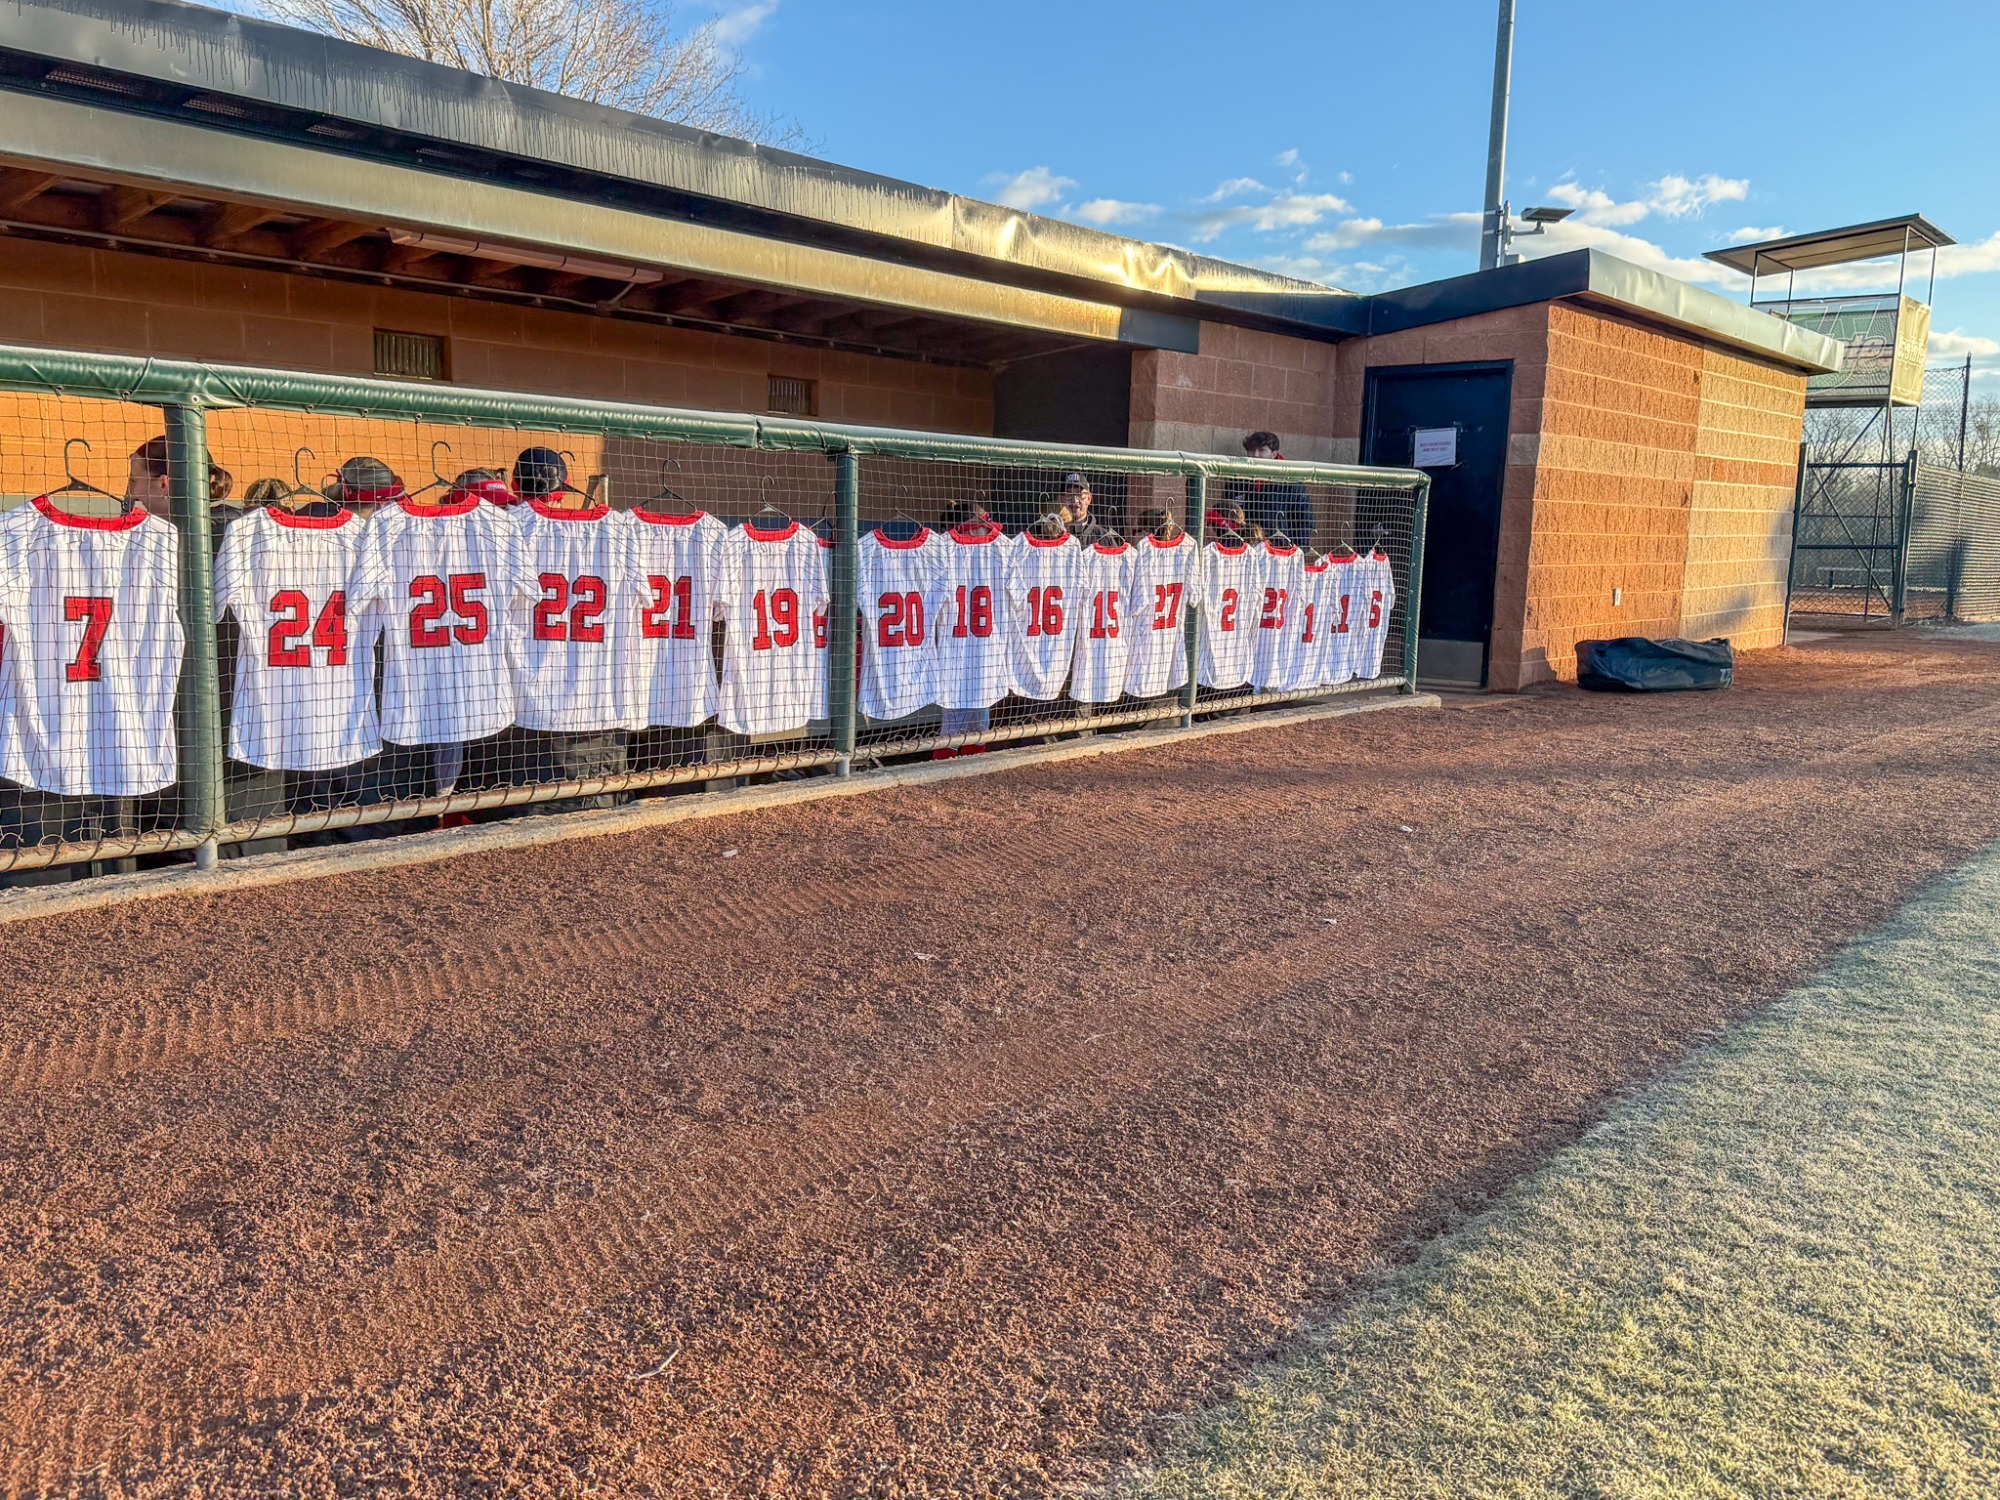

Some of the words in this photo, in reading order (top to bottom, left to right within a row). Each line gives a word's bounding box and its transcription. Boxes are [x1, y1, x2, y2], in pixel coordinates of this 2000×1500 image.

[268, 590, 348, 667] 24
[410, 573, 488, 648] 25
[534, 572, 607, 643] 22
[642, 574, 696, 640] 21
[753, 588, 799, 651] 19
[878, 591, 925, 648] 20
[952, 585, 993, 638] 18
[1027, 585, 1063, 637] 16
[1089, 590, 1120, 639] 15
[1152, 582, 1183, 631] 27
[1221, 588, 1238, 632] 2
[64, 596, 113, 682] 7
